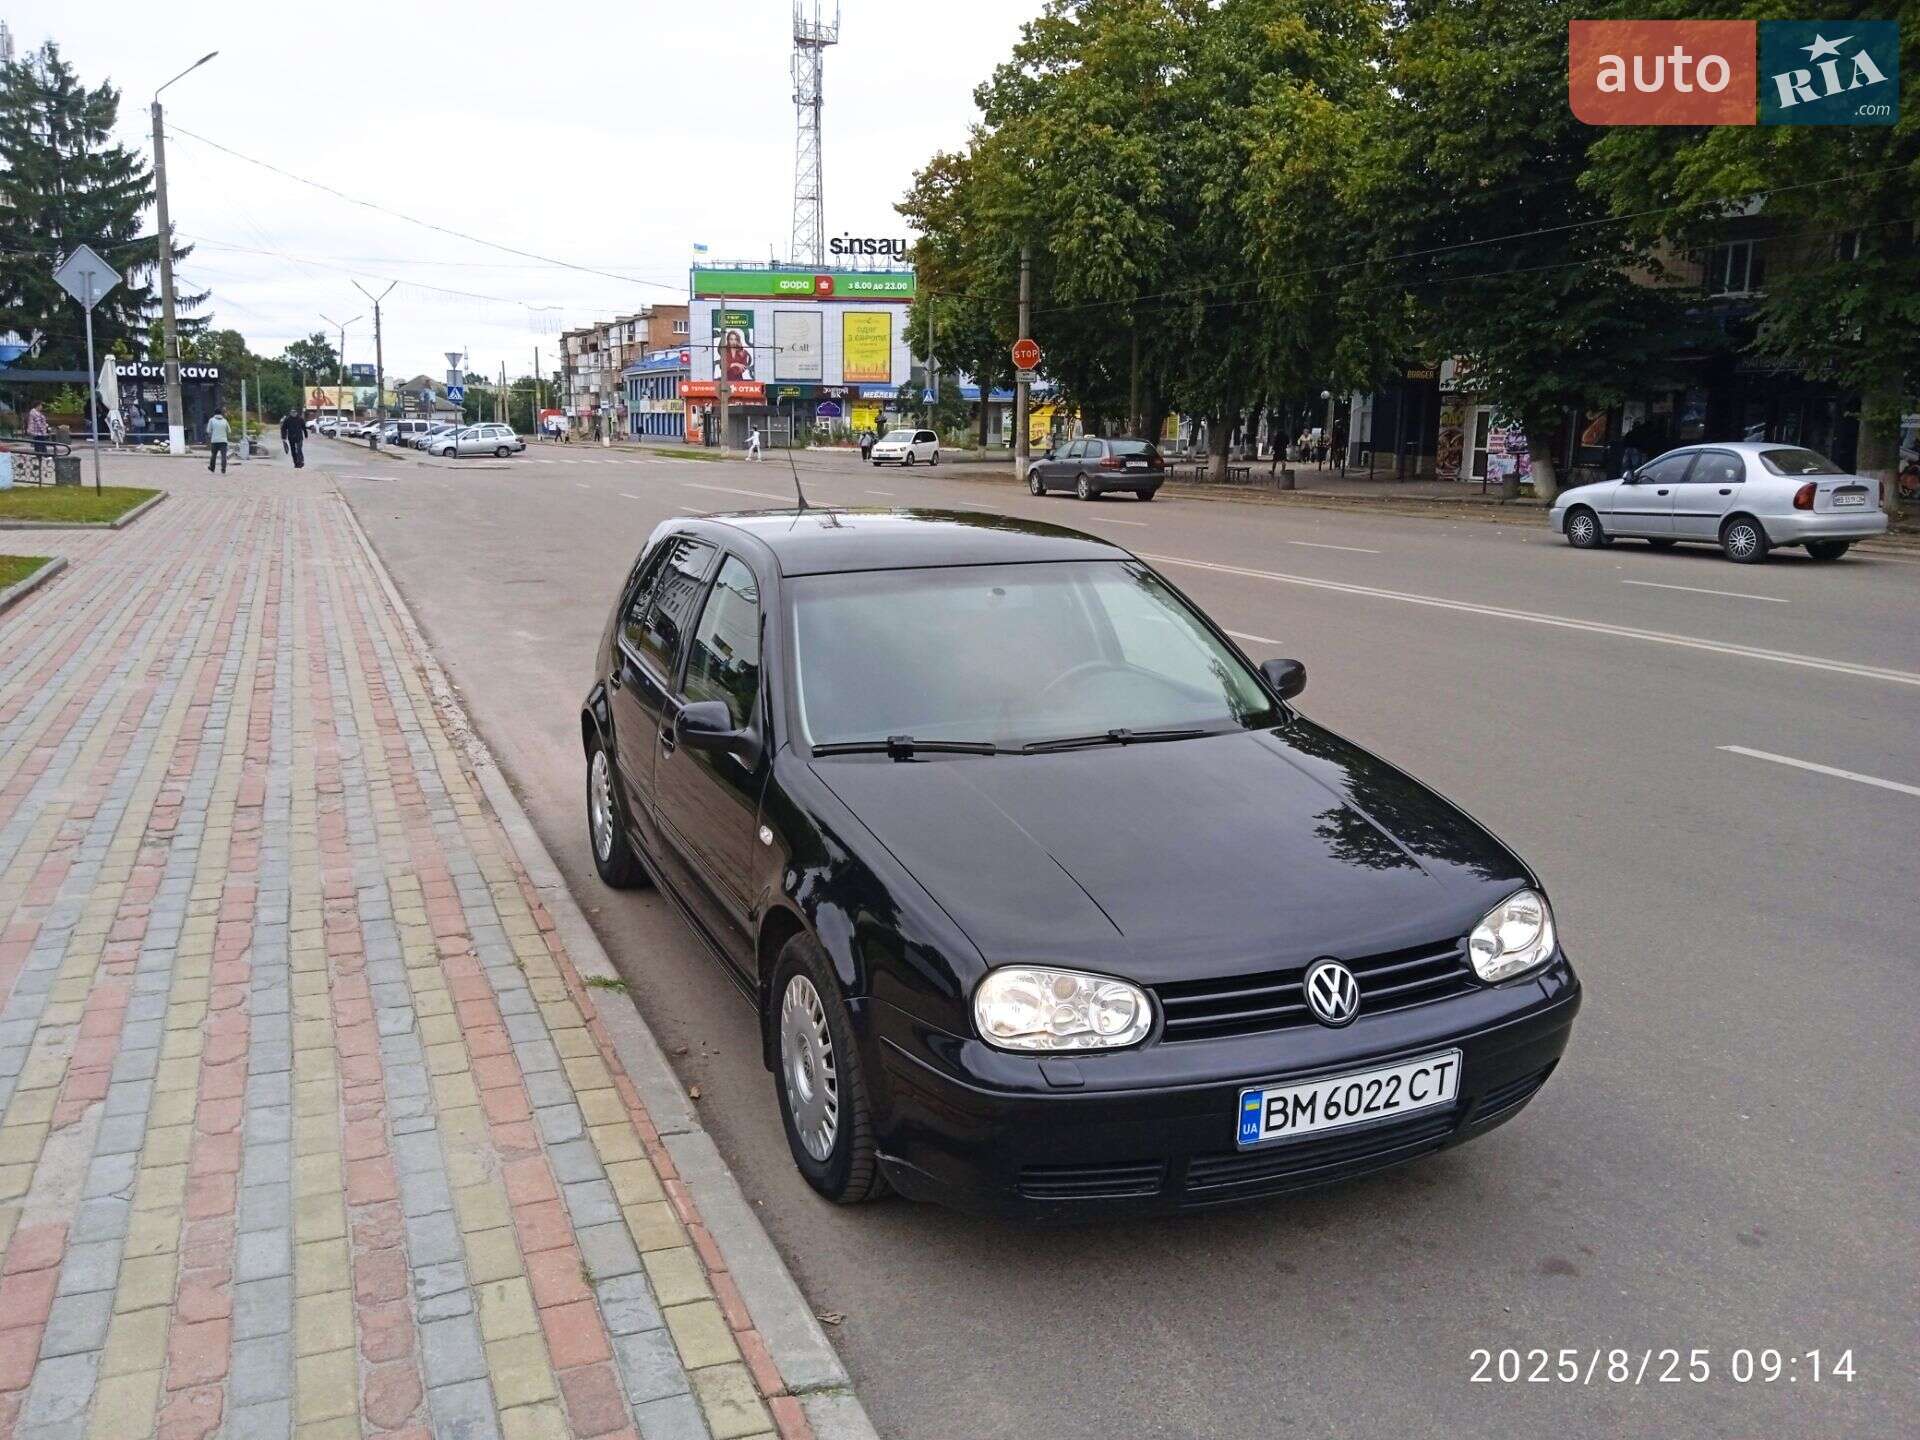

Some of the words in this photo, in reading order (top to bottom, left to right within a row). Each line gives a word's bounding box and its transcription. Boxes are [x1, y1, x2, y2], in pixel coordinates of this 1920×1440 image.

[829, 231, 906, 262] sinsay
[779, 280, 809, 290] фора
[884, 282, 908, 291] 23.00
[1014, 349, 1037, 359] STOP
[178, 366, 219, 379] kava
[1264, 1090, 1318, 1132] BM
[1324, 1074, 1402, 1121] 6022
[1408, 1061, 1454, 1101] CT
[1242, 1123, 1259, 1135] UA
